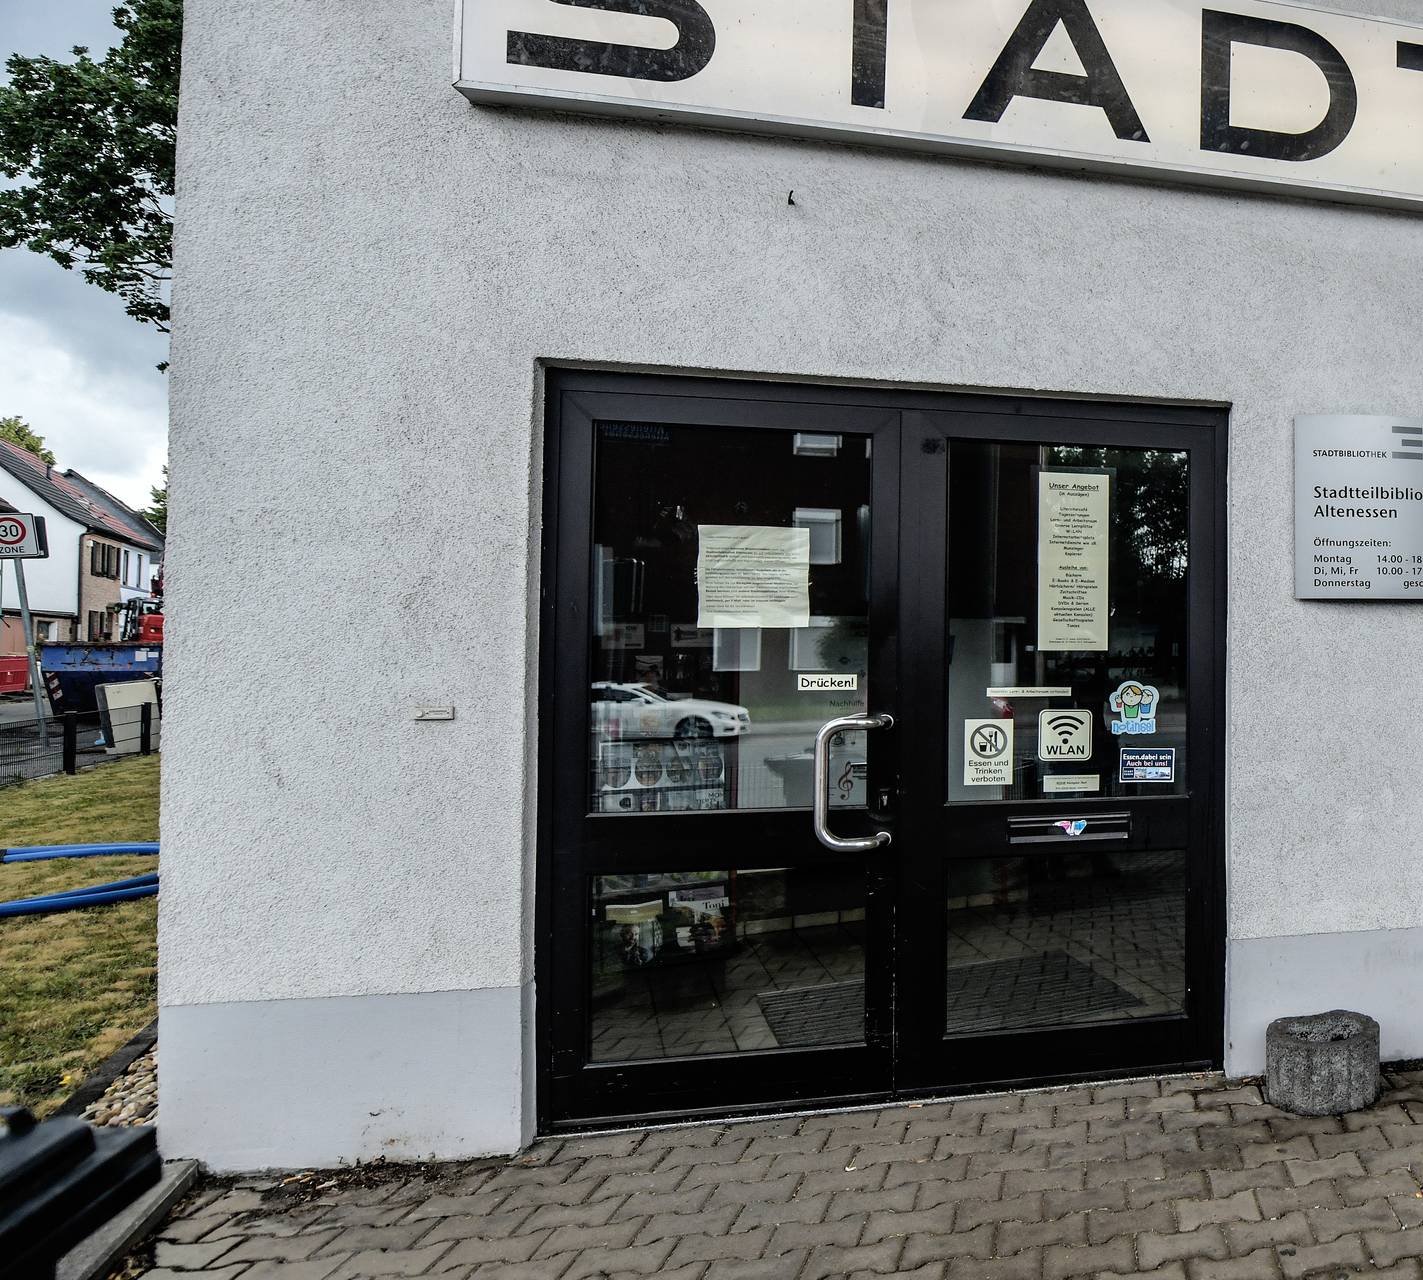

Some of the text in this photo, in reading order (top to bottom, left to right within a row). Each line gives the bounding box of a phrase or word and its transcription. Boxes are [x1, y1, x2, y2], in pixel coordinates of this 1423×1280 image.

[1312, 449, 1388, 459] STADTBIBLIOTHEK
[1048, 482, 1100, 492] Unser Angebot
[1313, 504, 1398, 519] Altenessen
[0, 524, 19, 538] 30
[1312, 537, 1392, 549] Öffnungszeiten:
[0, 545, 25, 554] ZONE
[1313, 554, 1353, 565] Montag
[1376, 555, 1403, 564] 14.00
[1313, 566, 1328, 576] Di,
[1330, 566, 1346, 576] Mi,
[1349, 567, 1359, 575] Fr
[1376, 567, 1403, 576] 10.00
[1313, 578, 1371, 589] Donnerstag
[801, 677, 854, 688] Drücken!
[1046, 745, 1085, 755] WLAN
[968, 759, 992, 767] Essen
[974, 767, 1003, 775] Trinken
[971, 775, 1006, 783] verboten
